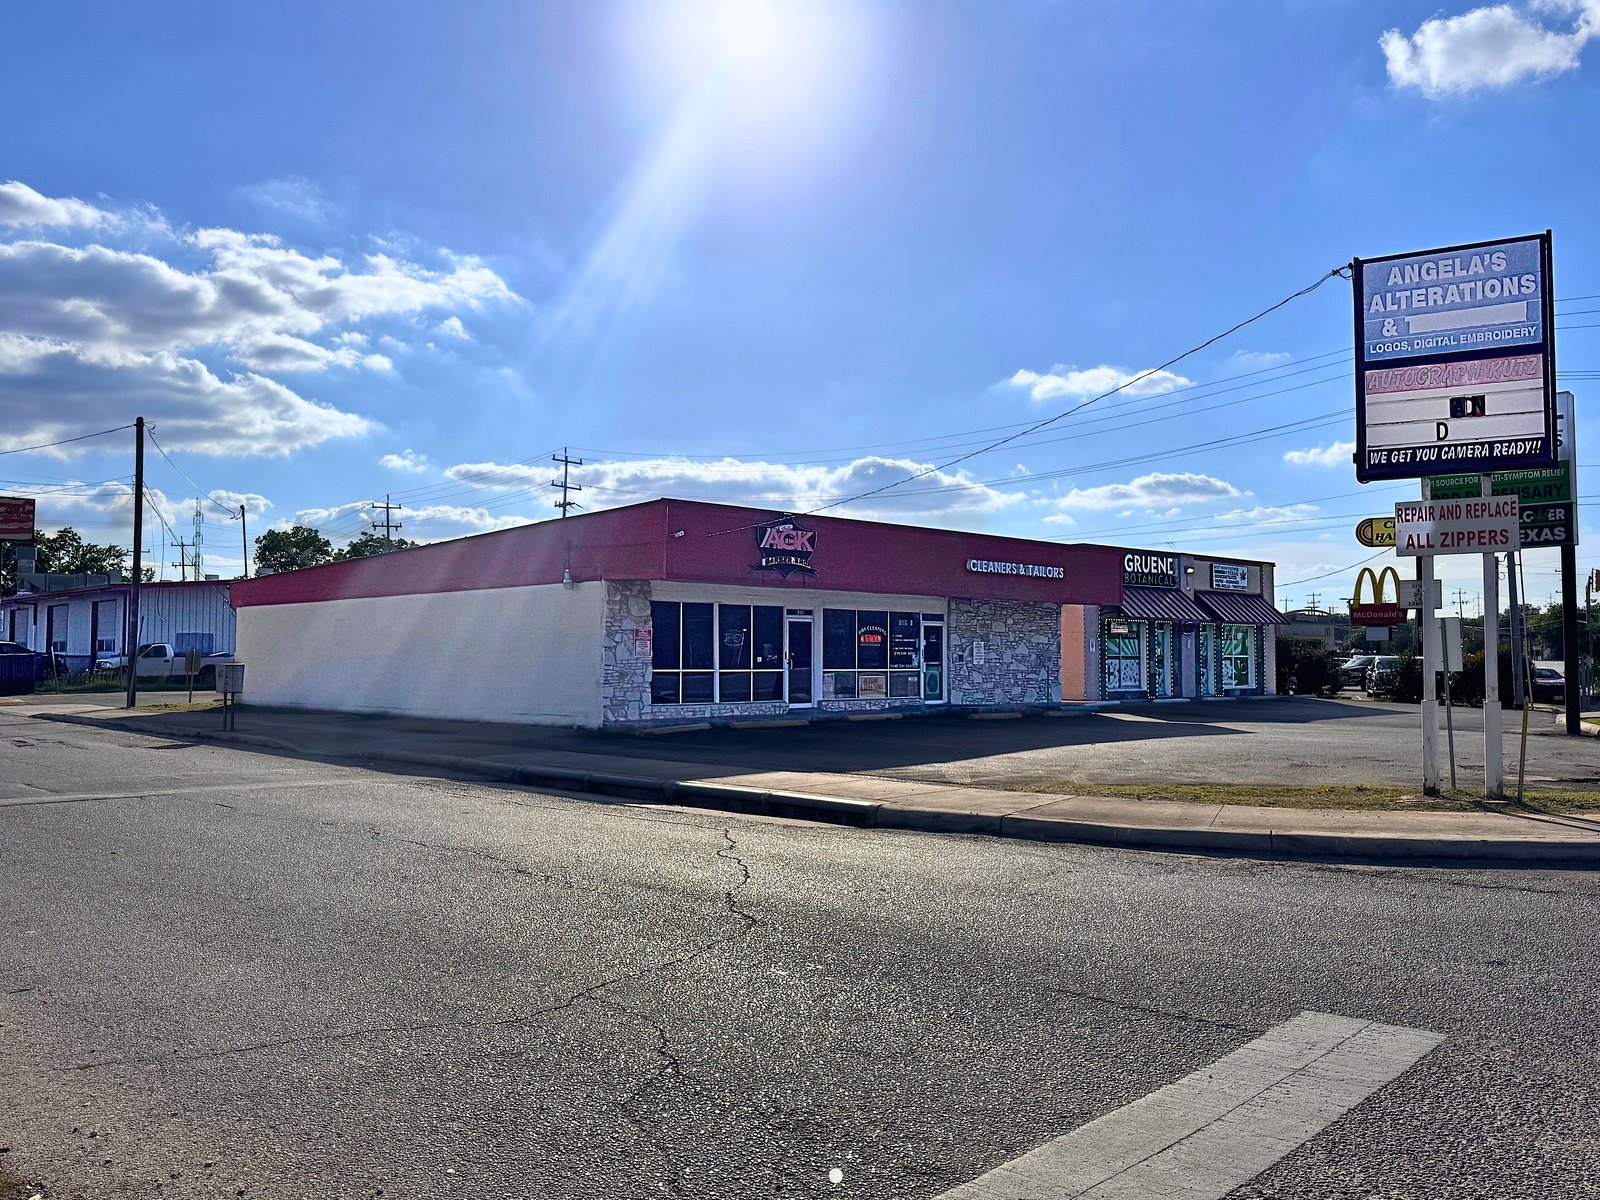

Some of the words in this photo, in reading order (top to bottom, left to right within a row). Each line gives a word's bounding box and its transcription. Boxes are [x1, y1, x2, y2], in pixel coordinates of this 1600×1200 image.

[1387, 251, 1507, 286] ANGELA'S
[1369, 274, 1536, 314] ALTERATIONS
[1381, 317, 1399, 337] &
[1369, 340, 1412, 354] LOGOS,
[1414, 335, 1458, 350] DIGITAL
[1459, 326, 1537, 345] EMBROIDERY
[1368, 361, 1482, 391] AUTOGRAPH
[1487, 357, 1538, 381] KUTZ
[1436, 421, 1449, 442] D
[1370, 451, 1388, 465] WE
[1390, 449, 1413, 463] GET
[1415, 447, 1438, 462] YOU
[1441, 443, 1490, 460] CAMERA
[1493, 440, 1542, 456] READY!!
[1436, 478, 1463, 487] SOURCE
[1465, 476, 1479, 484] FOR
[1480, 471, 1540, 483] LTI-SYMPTOM
[1542, 468, 1565, 478] RELIEF
[1397, 504, 1435, 524] REPAIR
[1439, 503, 1462, 521] AND
[1466, 500, 1517, 519] REPLACE
[1405, 532, 1435, 550] ALL
[1440, 528, 1509, 548] ZIPPERS
[1519, 526, 1566, 543] EXAS
[969, 559, 1017, 574] CLEANERS
[1019, 563, 1026, 575] &
[1028, 564, 1064, 579] TAILORS
[1353, 611, 1403, 619] McDonald's
